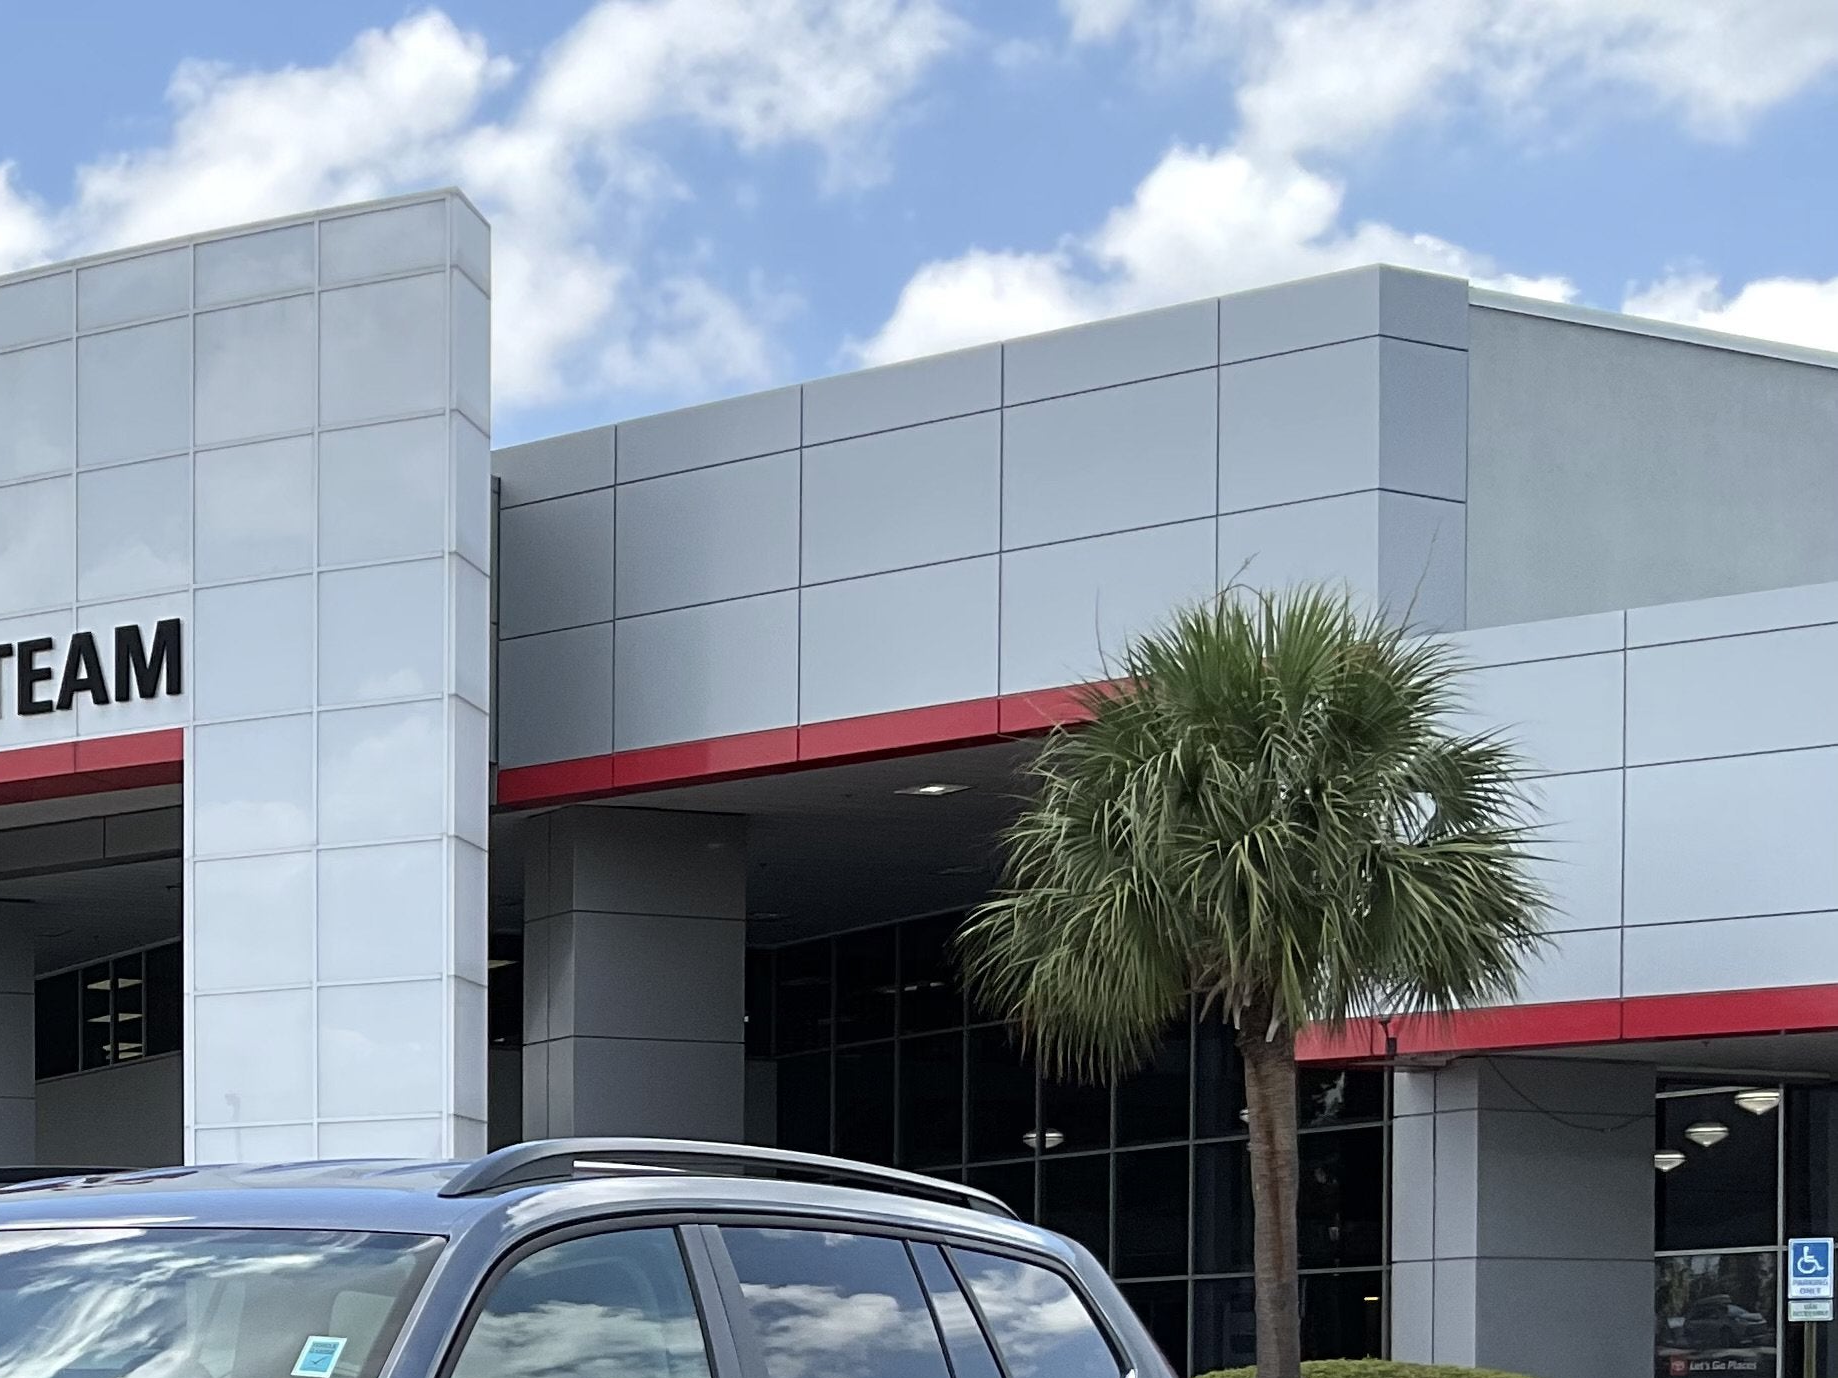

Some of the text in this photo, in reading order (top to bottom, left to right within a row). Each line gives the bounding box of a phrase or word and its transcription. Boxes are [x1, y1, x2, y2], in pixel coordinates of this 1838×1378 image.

[1689, 1360, 1757, 1371] Let's Go Places
